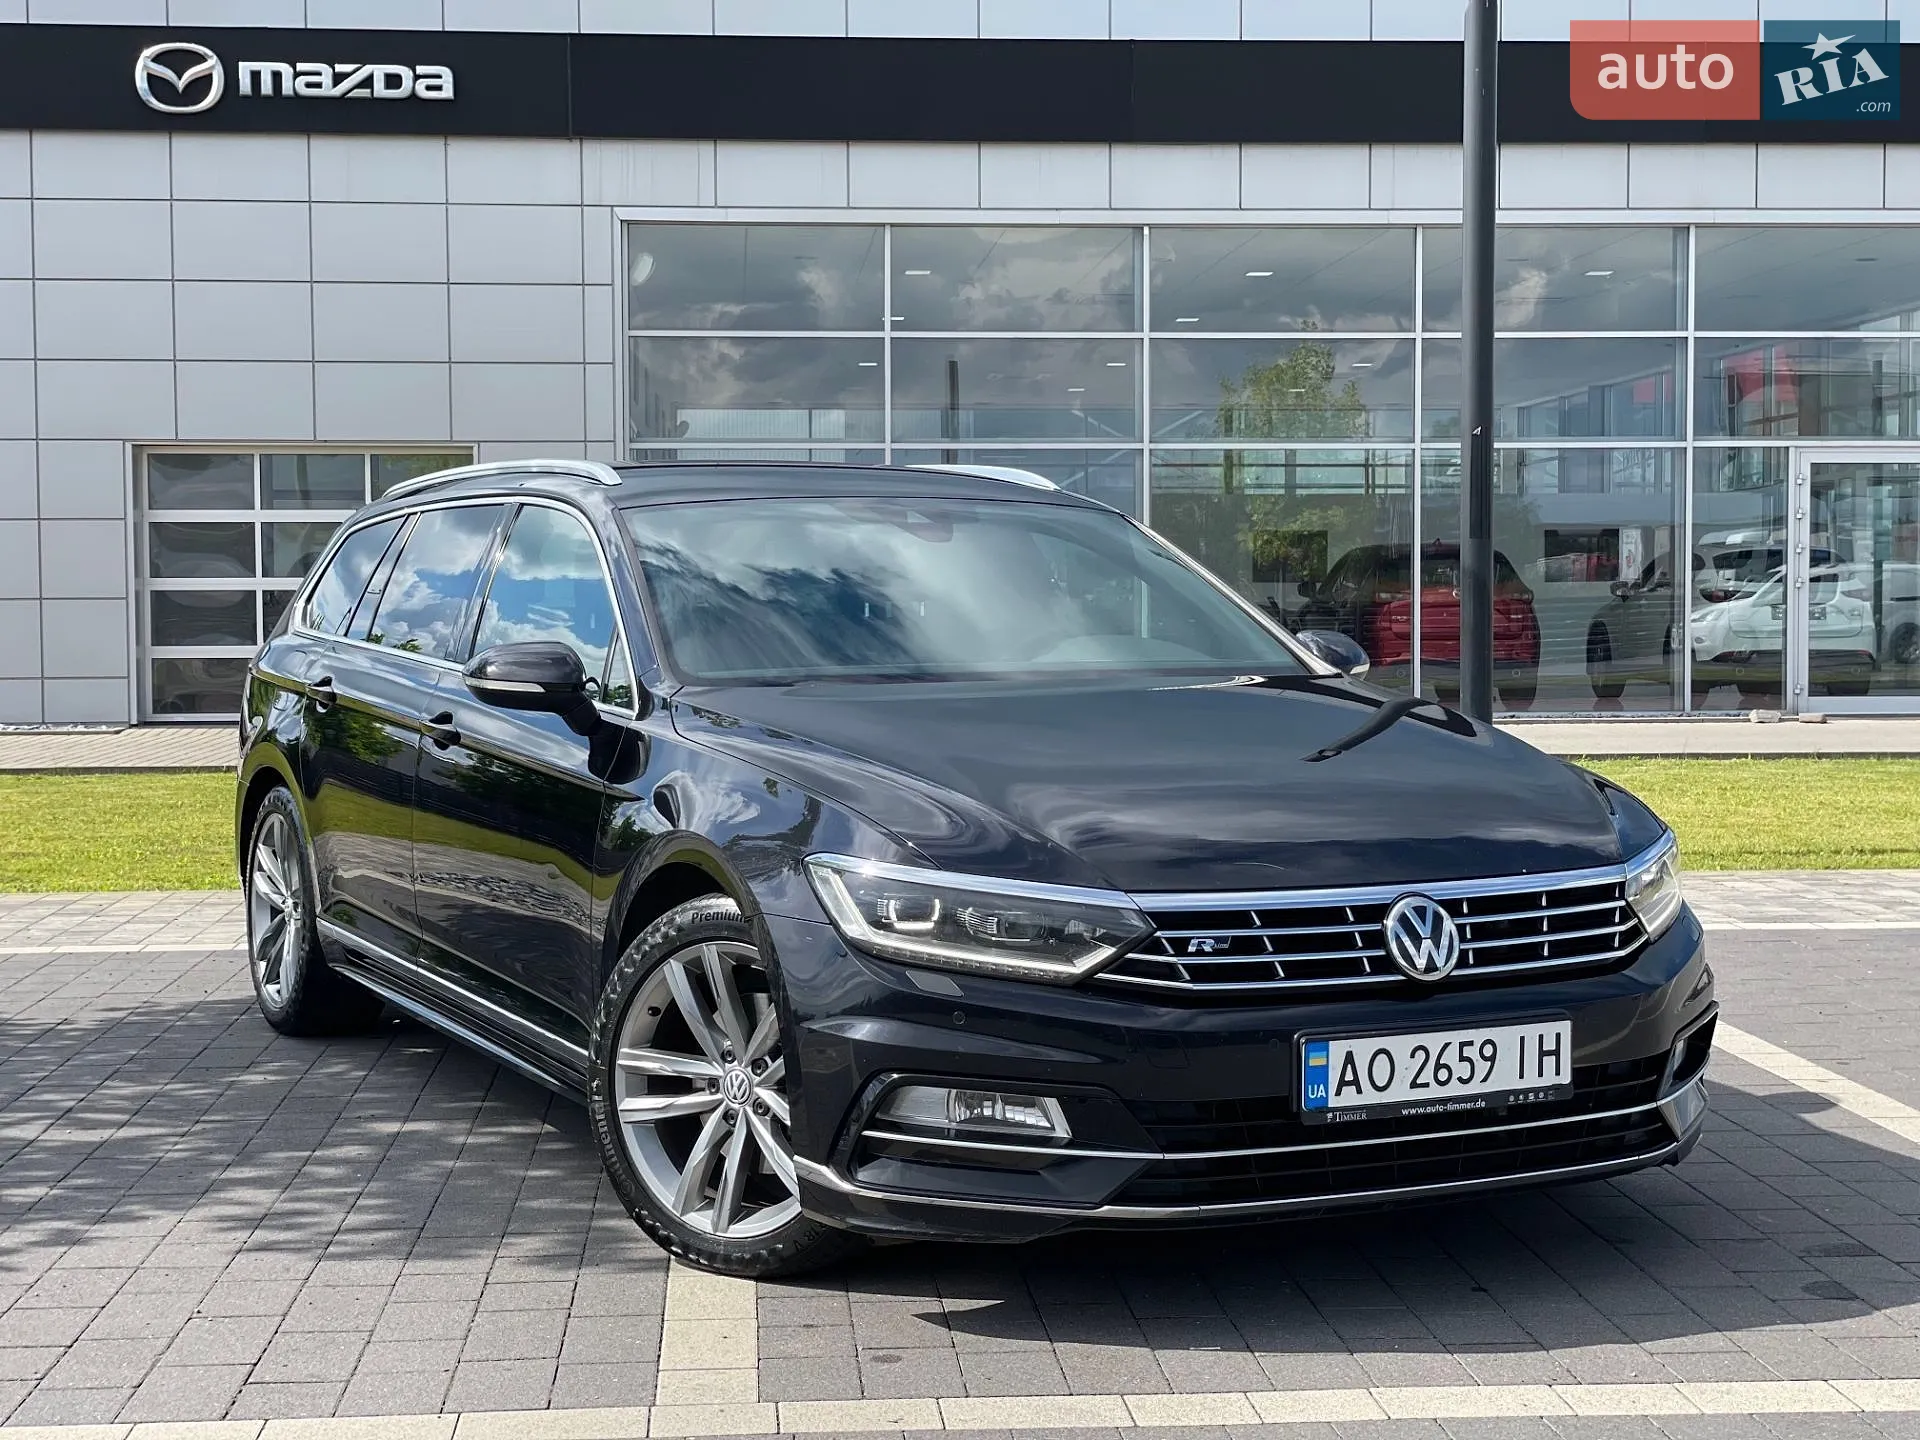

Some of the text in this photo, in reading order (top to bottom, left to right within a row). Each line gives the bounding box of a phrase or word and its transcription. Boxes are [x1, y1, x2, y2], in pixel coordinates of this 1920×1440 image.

[1334, 1031, 1562, 1097] AO 2659 IH
[1308, 1084, 1327, 1099] UA
[1401, 1100, 1486, 1116] www.auto-timmer.de
